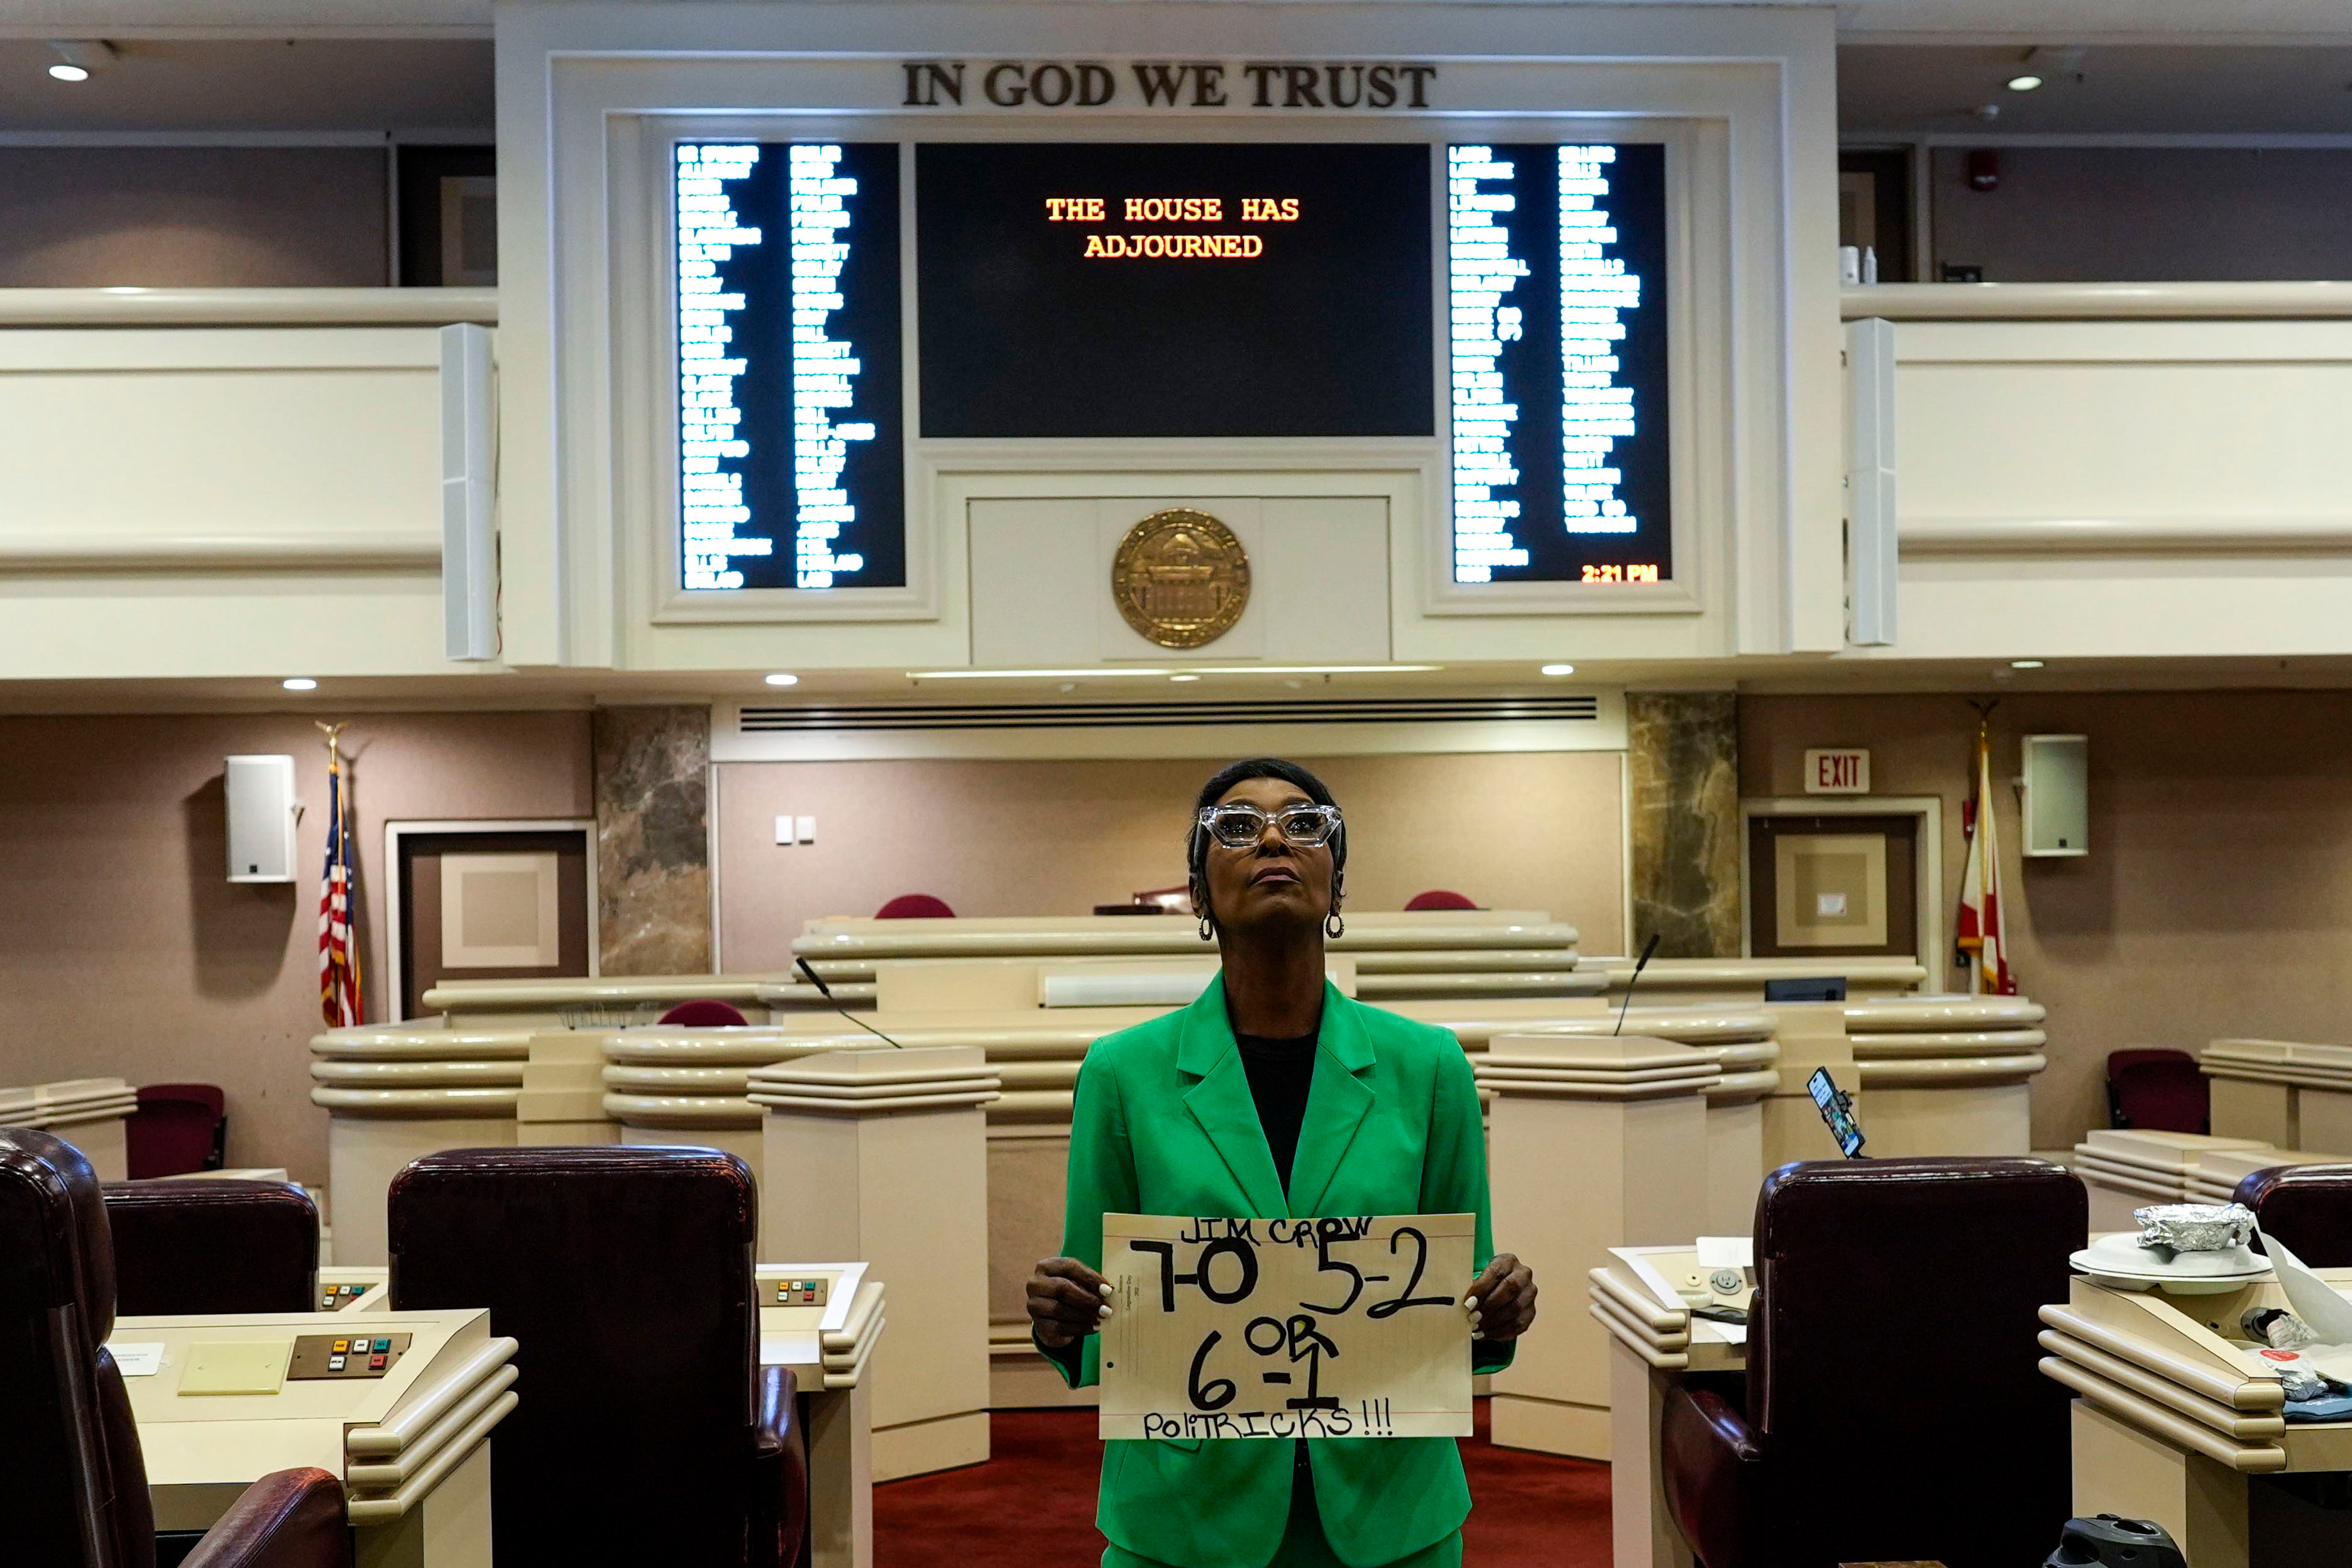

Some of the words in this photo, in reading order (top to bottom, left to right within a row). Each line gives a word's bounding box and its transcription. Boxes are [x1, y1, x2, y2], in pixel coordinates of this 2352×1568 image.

[901, 63, 965, 107] IN
[983, 62, 1116, 108] GOD
[1130, 63, 1229, 108] WE
[1243, 63, 1437, 109] TRUST
[1046, 198, 1105, 222] THE
[1124, 198, 1222, 222] HOUSE
[1241, 198, 1299, 222] HAS
[1084, 235, 1263, 258] ADJOURNED
[1581, 564, 1622, 583] 2:21
[1627, 564, 1659, 583] PM
[1819, 755, 1860, 787] EXIT
[1181, 1217, 1261, 1247] JIM
[1268, 1217, 1373, 1249] CROW
[1130, 1238, 1259, 1312] 7-0
[1299, 1226, 1455, 1319] 5-2
[1245, 1314, 1339, 1360] OR
